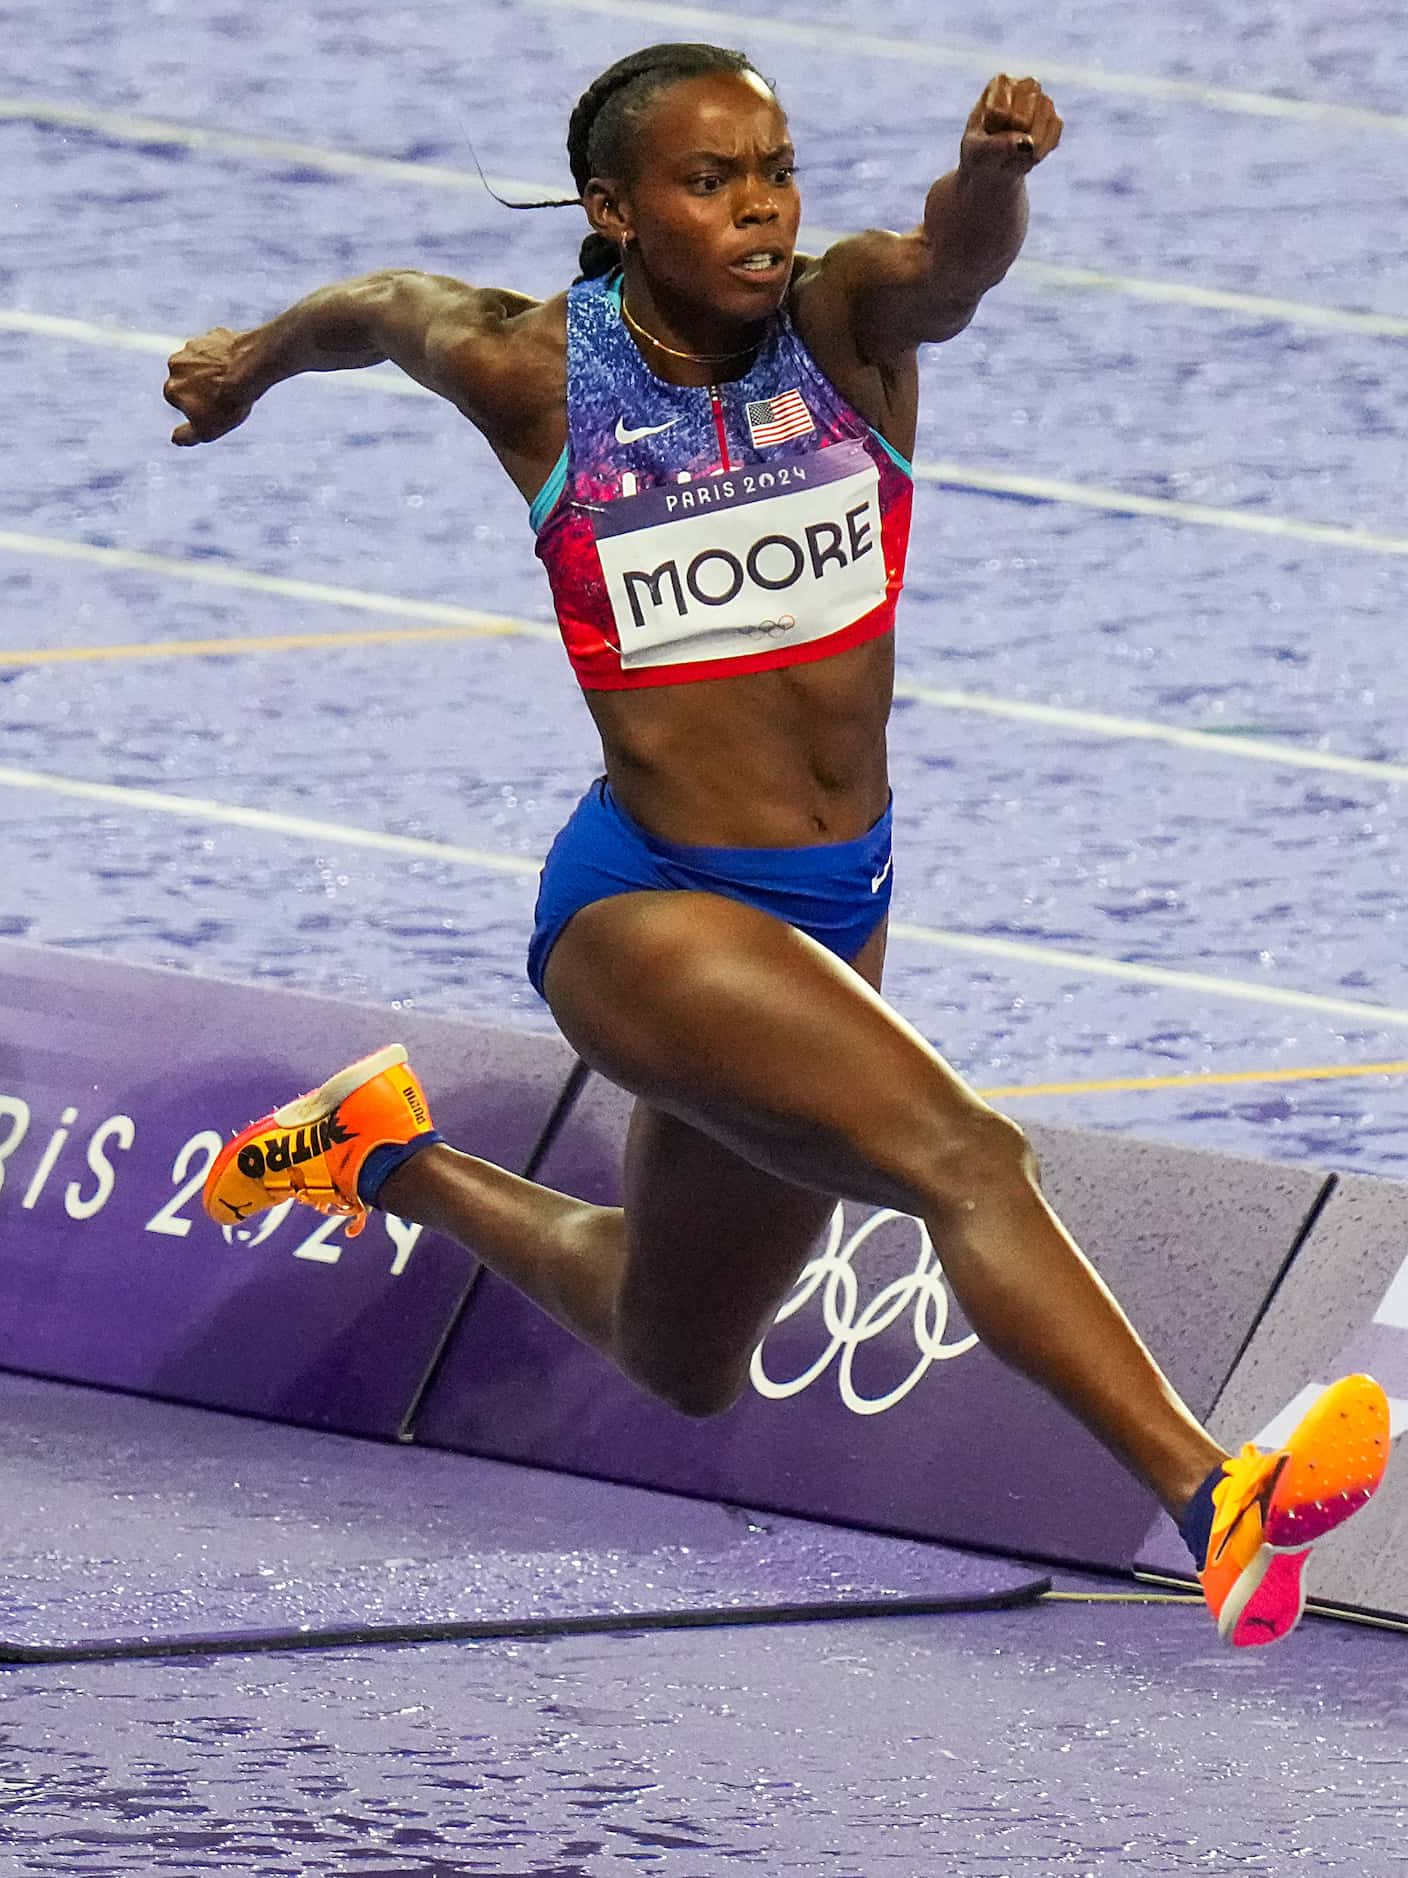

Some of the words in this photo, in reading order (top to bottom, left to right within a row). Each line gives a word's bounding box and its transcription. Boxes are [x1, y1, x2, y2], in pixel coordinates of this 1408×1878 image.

[743, 466, 806, 493] 2024
[623, 502, 873, 627] MOORE
[237, 1105, 360, 1179] NITRO
